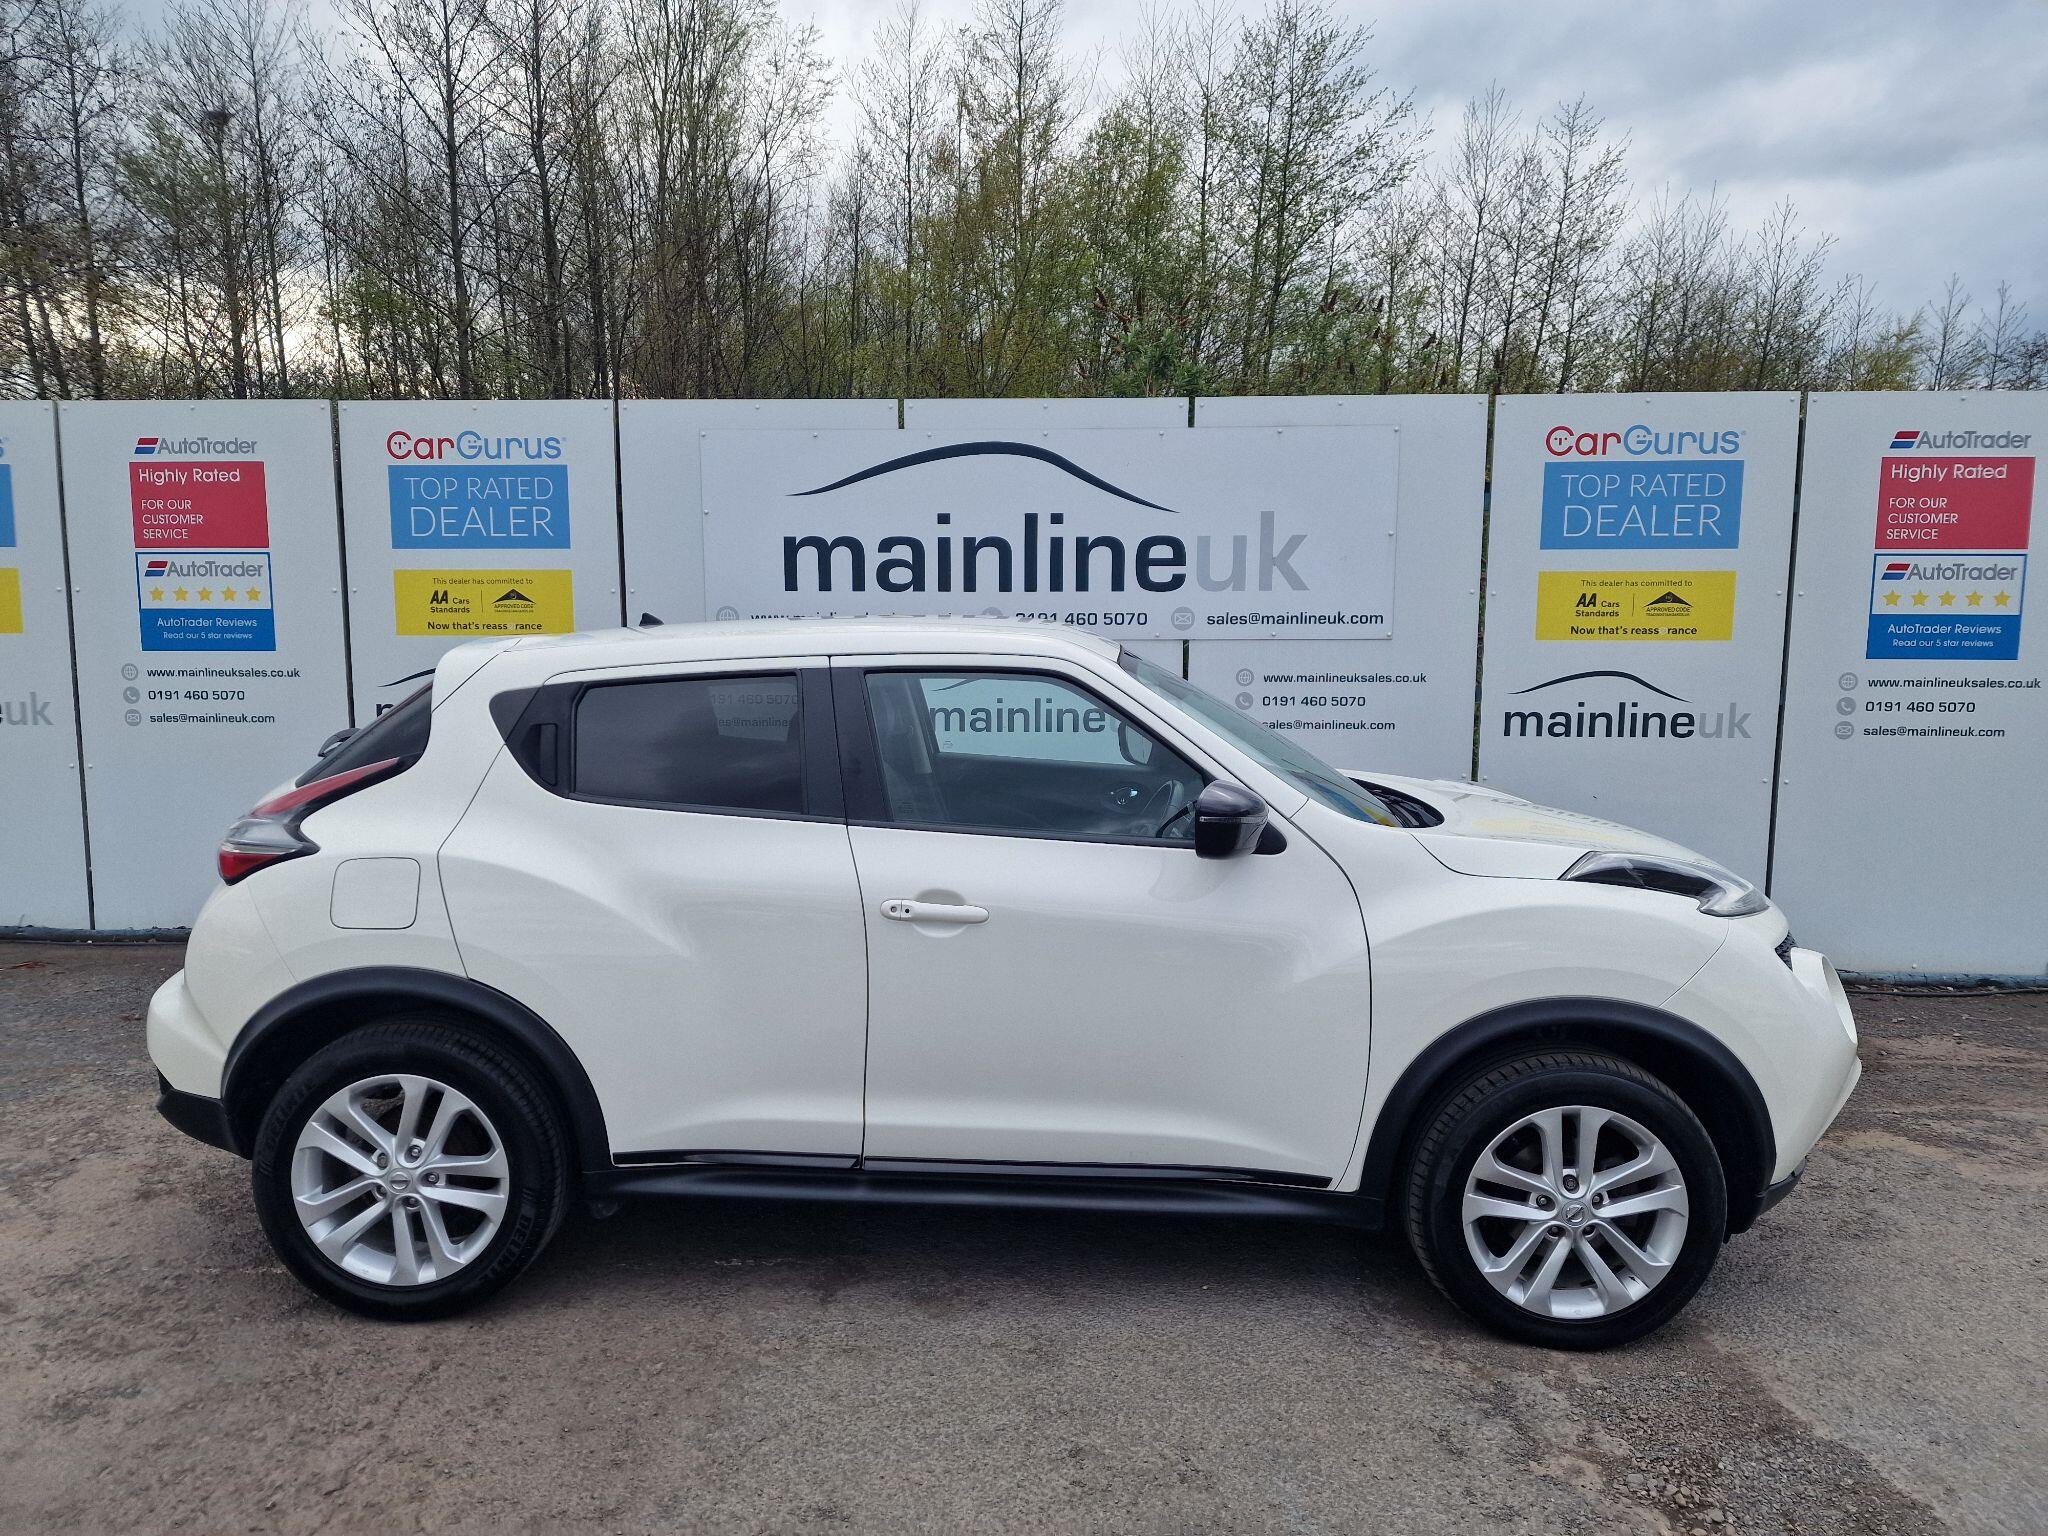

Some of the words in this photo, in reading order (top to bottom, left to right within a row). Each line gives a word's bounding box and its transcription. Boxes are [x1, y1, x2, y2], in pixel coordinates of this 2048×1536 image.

[387, 430, 562, 460] CarGurus
[1545, 424, 1740, 456] CarGurus
[1916, 430, 2031, 449] AutoTrader
[157, 437, 257, 455] AutoTrader
[139, 469, 187, 485] Highly
[193, 468, 240, 482] Rated
[1891, 464, 1948, 483] Highly
[1953, 464, 2007, 479] Rated
[404, 477, 458, 500] TOP
[467, 477, 553, 500] RATED
[1561, 474, 1620, 498] TOP
[1630, 473, 1726, 497] RATED
[141, 499, 165, 510] FOR
[167, 499, 192, 510] OUR
[1889, 497, 1916, 509] FOR
[1920, 497, 1947, 509] OUR
[142, 514, 203, 525] CUSTOMER
[410, 506, 554, 537] DEALER
[1563, 504, 1722, 537] DEALER
[1888, 513, 1958, 524] CUSTOMER
[143, 529, 188, 539] SERVICE
[1886, 528, 1938, 540] SERVICE
[784, 511, 1310, 593] mainlineuk
[166, 561, 263, 577] AutoTrader
[1907, 563, 2018, 581] AutoTrader
[430, 590, 448, 604] AA
[1576, 593, 1597, 607] AA
[157, 617, 213, 627] AutoTrader
[216, 617, 258, 627] Reviews
[1064, 613, 1098, 625] 460
[1103, 613, 1148, 625] 5070
[1207, 611, 1384, 625] sales@mainlineuk.com
[428, 622, 450, 630] Now
[452, 622, 480, 630] that's
[482, 622, 542, 630] reassrance
[1570, 626, 1595, 634] Now
[1598, 626, 1628, 634] that's
[1888, 623, 1951, 634] AutoTrader
[1955, 623, 2002, 634] Reviews
[163, 631, 183, 639] Read
[200, 631, 206, 639] 5
[207, 631, 222, 639] star
[1893, 639, 1916, 647] Read
[1936, 639, 1942, 647] 5
[1943, 639, 1959, 647] star
[147, 668, 300, 678] www.mainlineuksales.co.uk
[1263, 673, 1427, 683] www.mainlineuksales.co.uk
[1868, 677, 2041, 689] www.mainlineuksales.co.uk
[148, 690, 181, 701] 0191
[184, 690, 209, 701] 460
[212, 690, 245, 701] 5070
[1262, 696, 1295, 706] 0191
[1301, 696, 1327, 706] 460
[1331, 696, 1366, 706] 5070
[0, 692, 54, 726] uk
[1865, 701, 1901, 713] 0191
[1906, 701, 1934, 713] 460
[1938, 701, 1975, 713] 5070
[149, 713, 275, 724] sales@mainlineuk.com
[1503, 702, 1752, 739] mainlineuk
[1863, 726, 2005, 738] sales@mainlineuk.com
